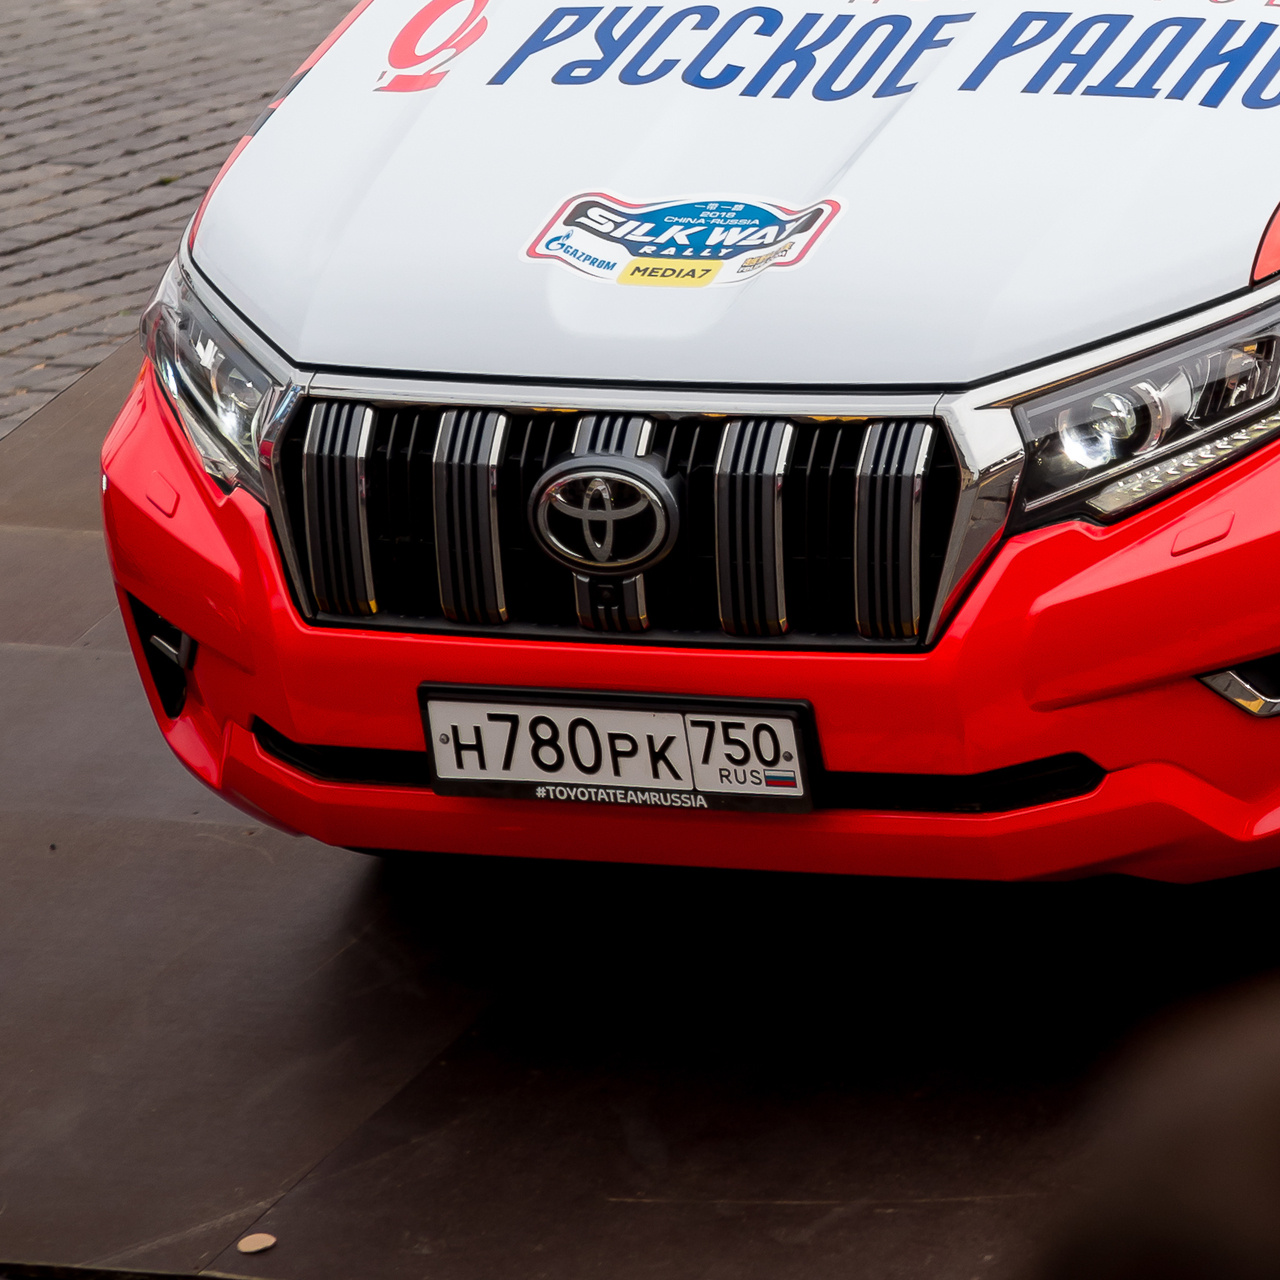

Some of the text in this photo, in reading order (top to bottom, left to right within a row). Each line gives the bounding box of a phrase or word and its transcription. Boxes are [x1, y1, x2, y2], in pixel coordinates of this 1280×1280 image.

[486, 4, 978, 103] РУССКОЕ
[574, 207, 815, 246] SILK WAY
[664, 216, 760, 225] CHINA-RUSSIA
[563, 245, 617, 272] GAZPROM
[638, 246, 735, 257] RALLY
[630, 266, 712, 279] MEDIA7
[690, 719, 782, 767] 750
[719, 768, 763, 786] RUS
[536, 785, 708, 809] #TOYOTATEAMRUSSIA
